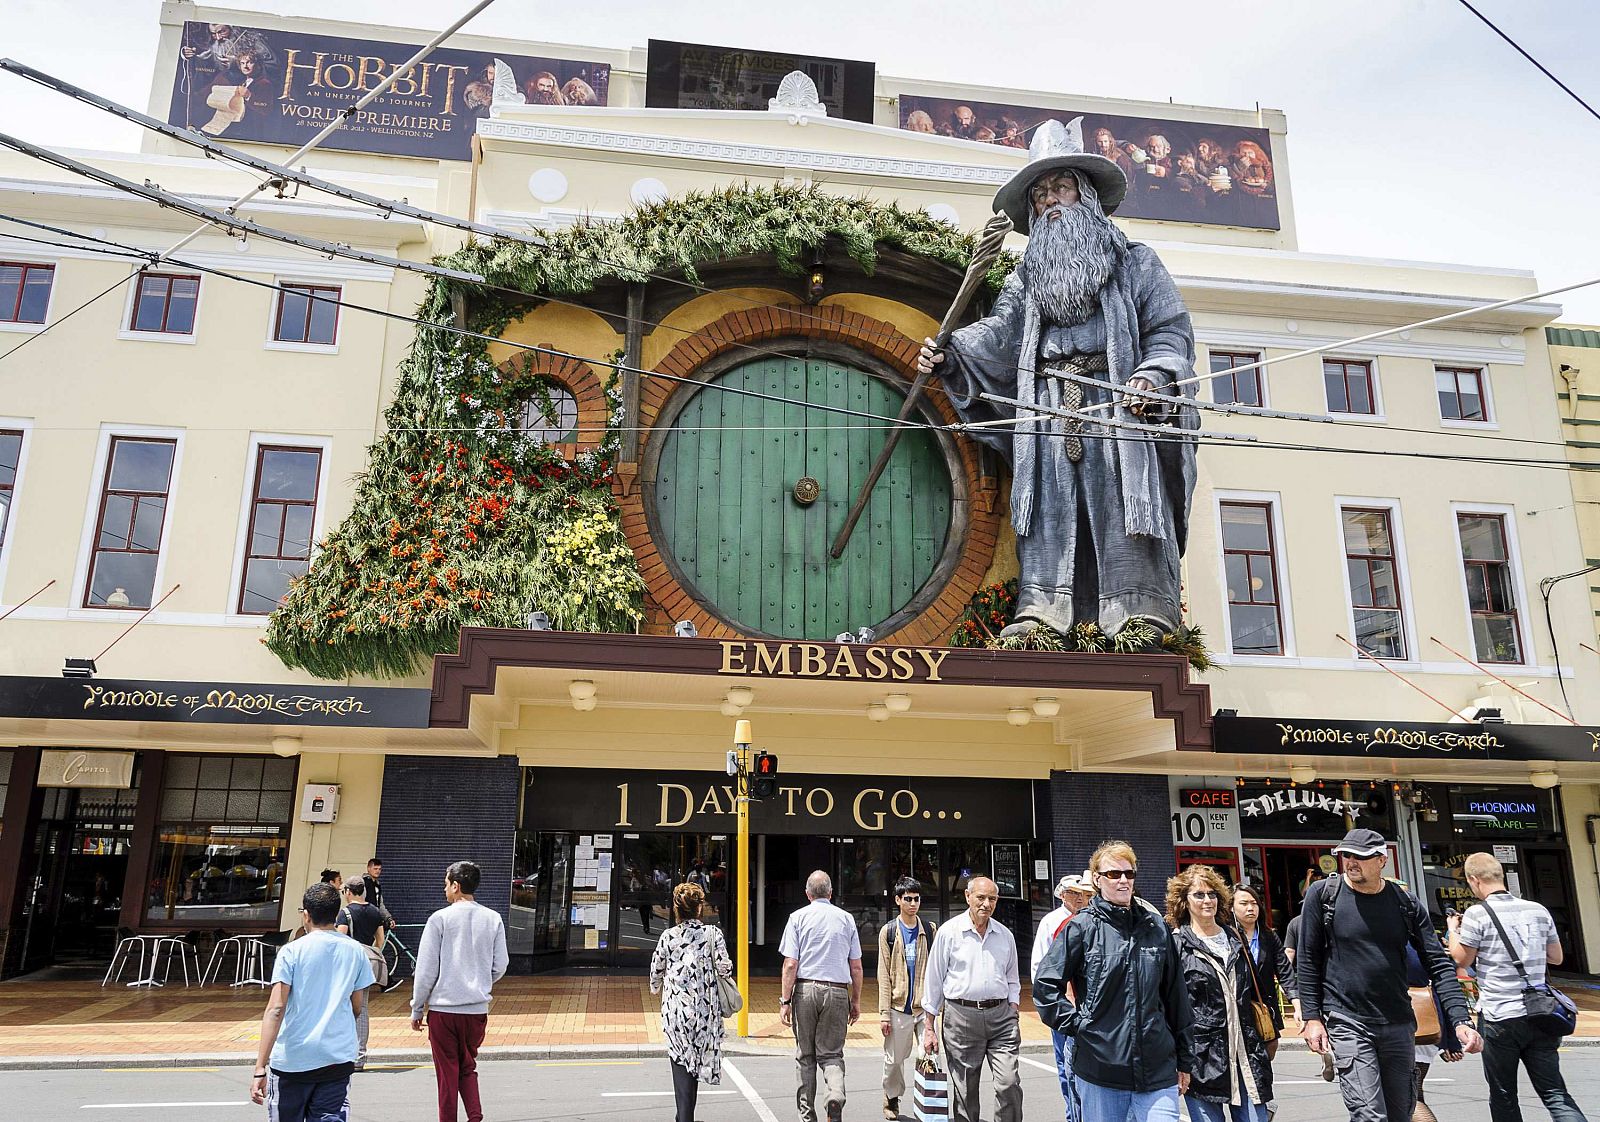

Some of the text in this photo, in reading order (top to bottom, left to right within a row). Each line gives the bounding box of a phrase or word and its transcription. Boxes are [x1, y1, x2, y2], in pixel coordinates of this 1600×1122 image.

[332, 53, 354, 63] THE
[277, 48, 469, 116] HOBBIT
[325, 92, 385, 103] UNEXPEED
[389, 98, 433, 108] JOURNEY
[350, 125, 366, 133] 2012
[355, 110, 452, 132] PREMIERE
[717, 641, 951, 682] EMBASSY
[62, 753, 111, 784] CAPITOL
[614, 782, 963, 832] 1 DAY TO GO...
[1190, 792, 1231, 806] CAFE
[1258, 789, 1346, 818] DELUXE
[1470, 802, 1536, 814] PHOENICIAN
[1171, 812, 1229, 844] 10 KENT
[1211, 822, 1226, 831] TCE
[1487, 820, 1525, 830] FALAFEL
